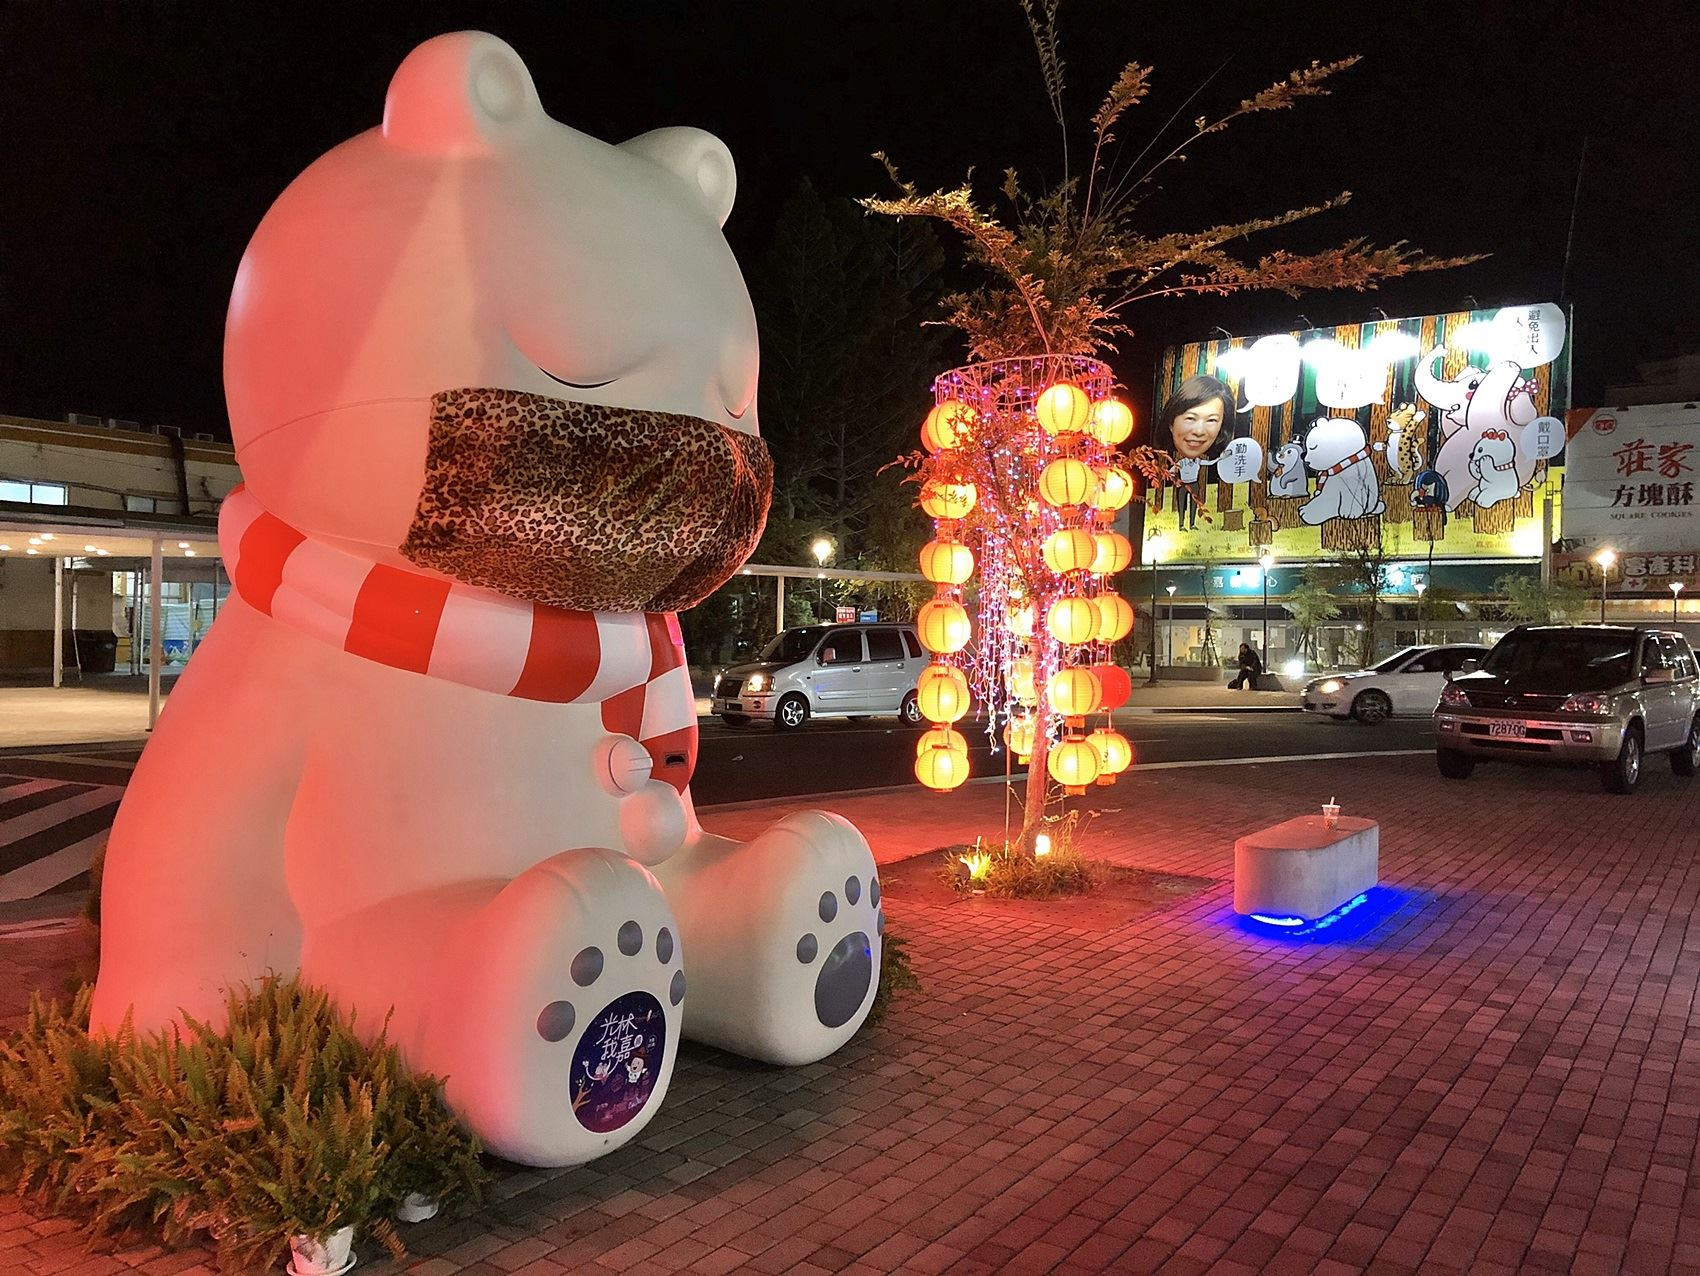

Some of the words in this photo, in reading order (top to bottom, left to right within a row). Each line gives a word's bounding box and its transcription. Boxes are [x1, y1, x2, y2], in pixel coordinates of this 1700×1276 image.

[1537, 421, 1551, 457] 戴口罩
[1234, 443, 1247, 477] 勤洗手
[1612, 438, 1694, 478] 莊家
[1610, 481, 1695, 508] 方塊酥
[596, 1012, 638, 1045] 光林
